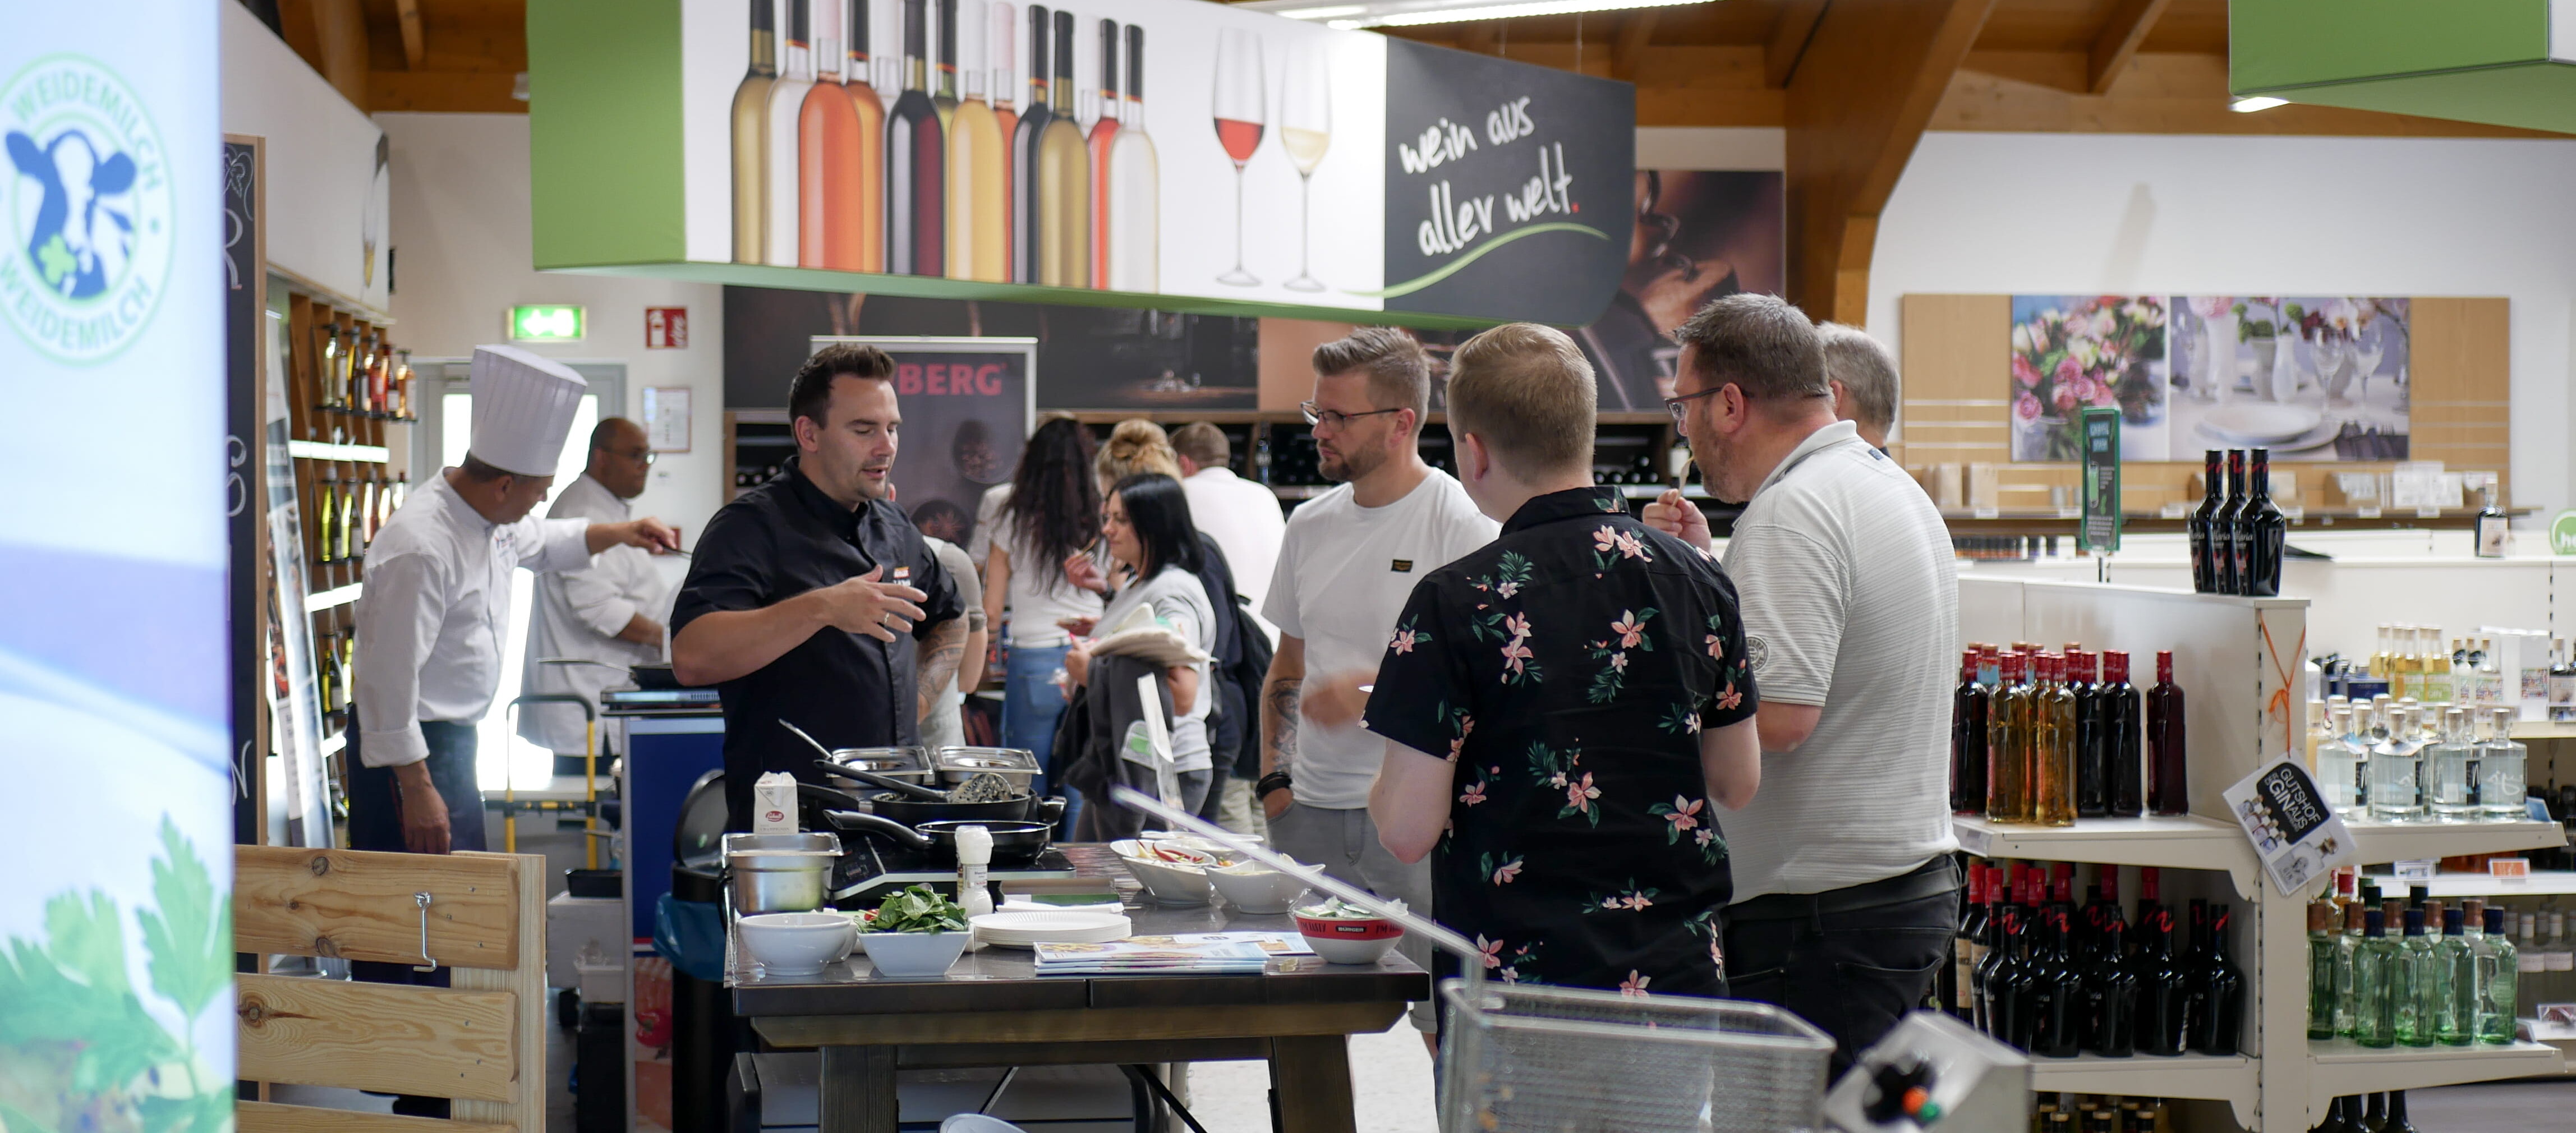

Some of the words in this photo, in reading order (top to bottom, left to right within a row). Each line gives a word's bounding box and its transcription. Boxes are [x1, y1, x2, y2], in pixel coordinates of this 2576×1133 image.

[14, 70, 161, 190] WEIDEMILCH
[1399, 116, 1478, 174] wein
[1486, 95, 1535, 146] aus
[1417, 179, 1495, 257] aller
[1, 252, 150, 350] WEIDEMILCH
[892, 362, 1003, 396] BERG
[2269, 779, 2296, 812] GIN
[2288, 805, 2308, 830] AUS
[2280, 768, 2321, 823] GUTSHOF
